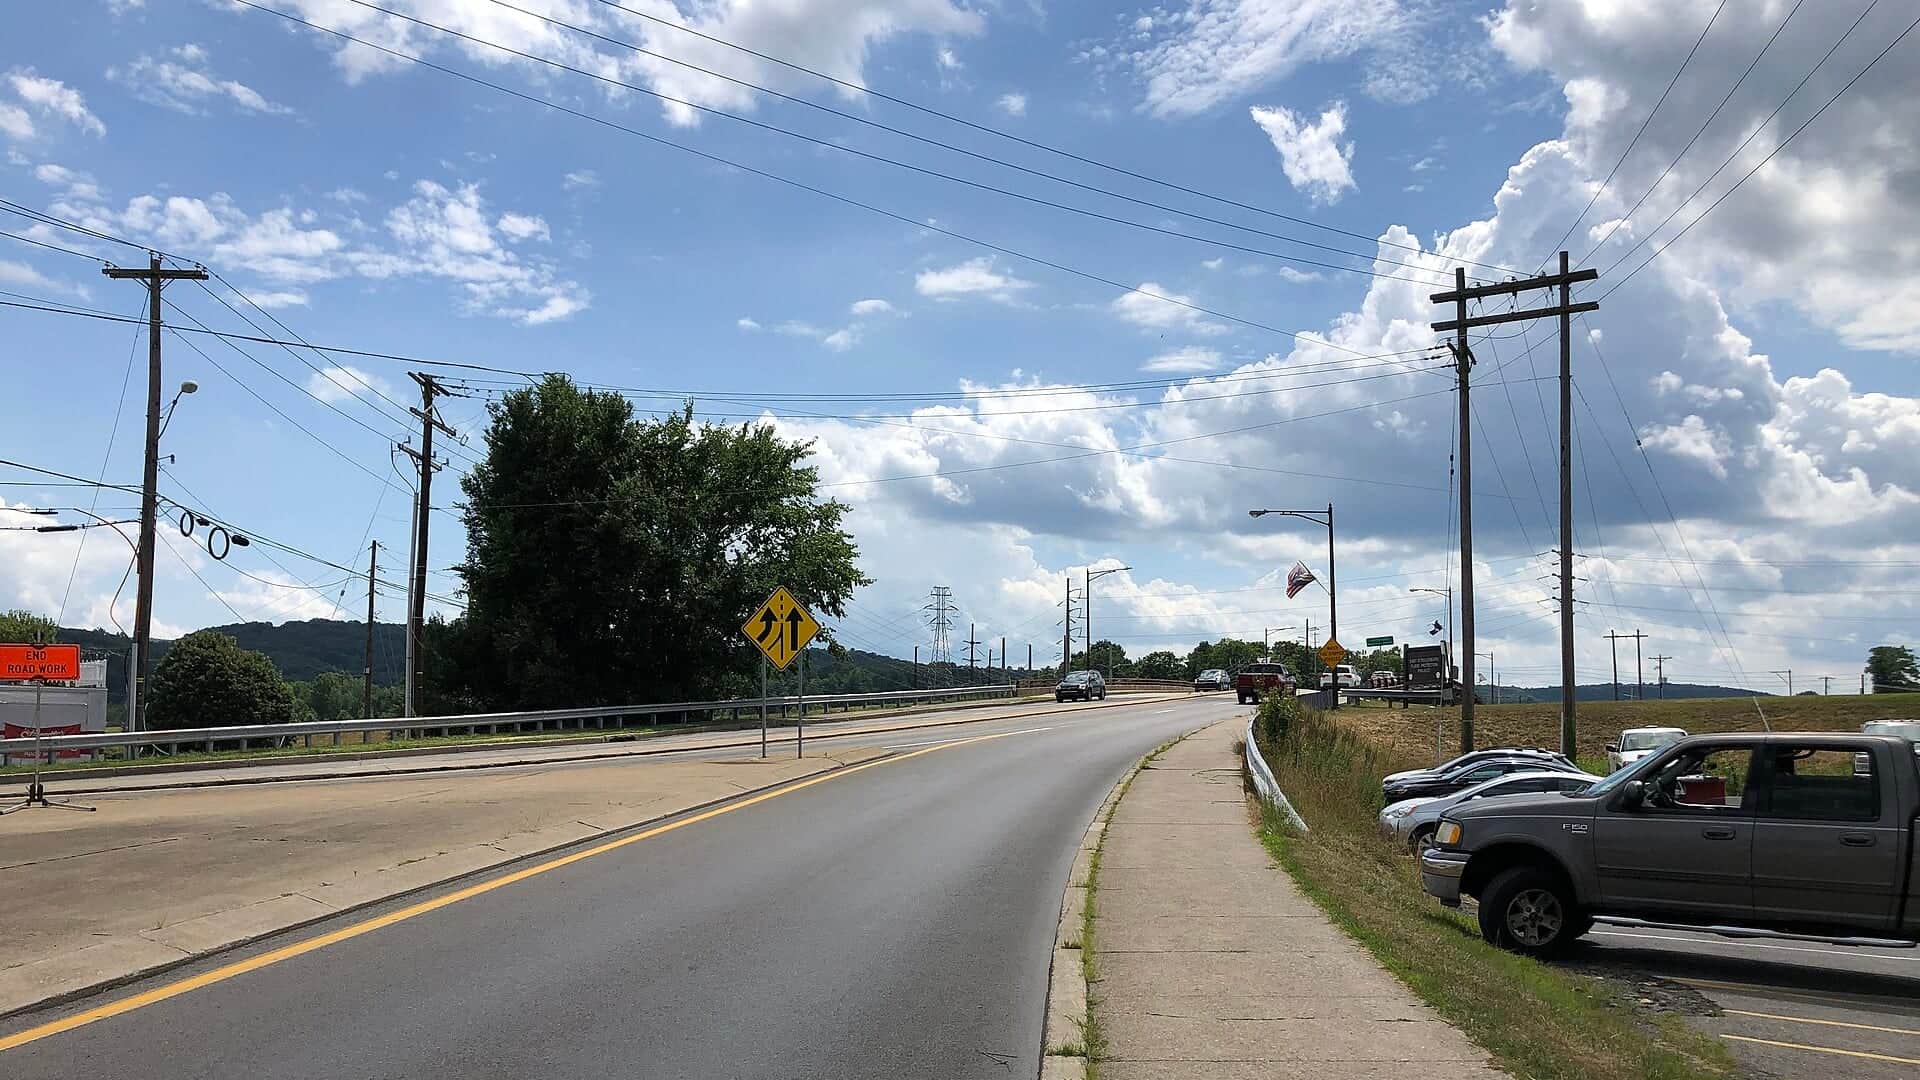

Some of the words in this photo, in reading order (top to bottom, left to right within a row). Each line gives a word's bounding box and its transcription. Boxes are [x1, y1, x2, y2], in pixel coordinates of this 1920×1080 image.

[26, 651, 46, 660] END
[7, 664, 36, 674] ROAD
[39, 664, 67, 674] WORK
